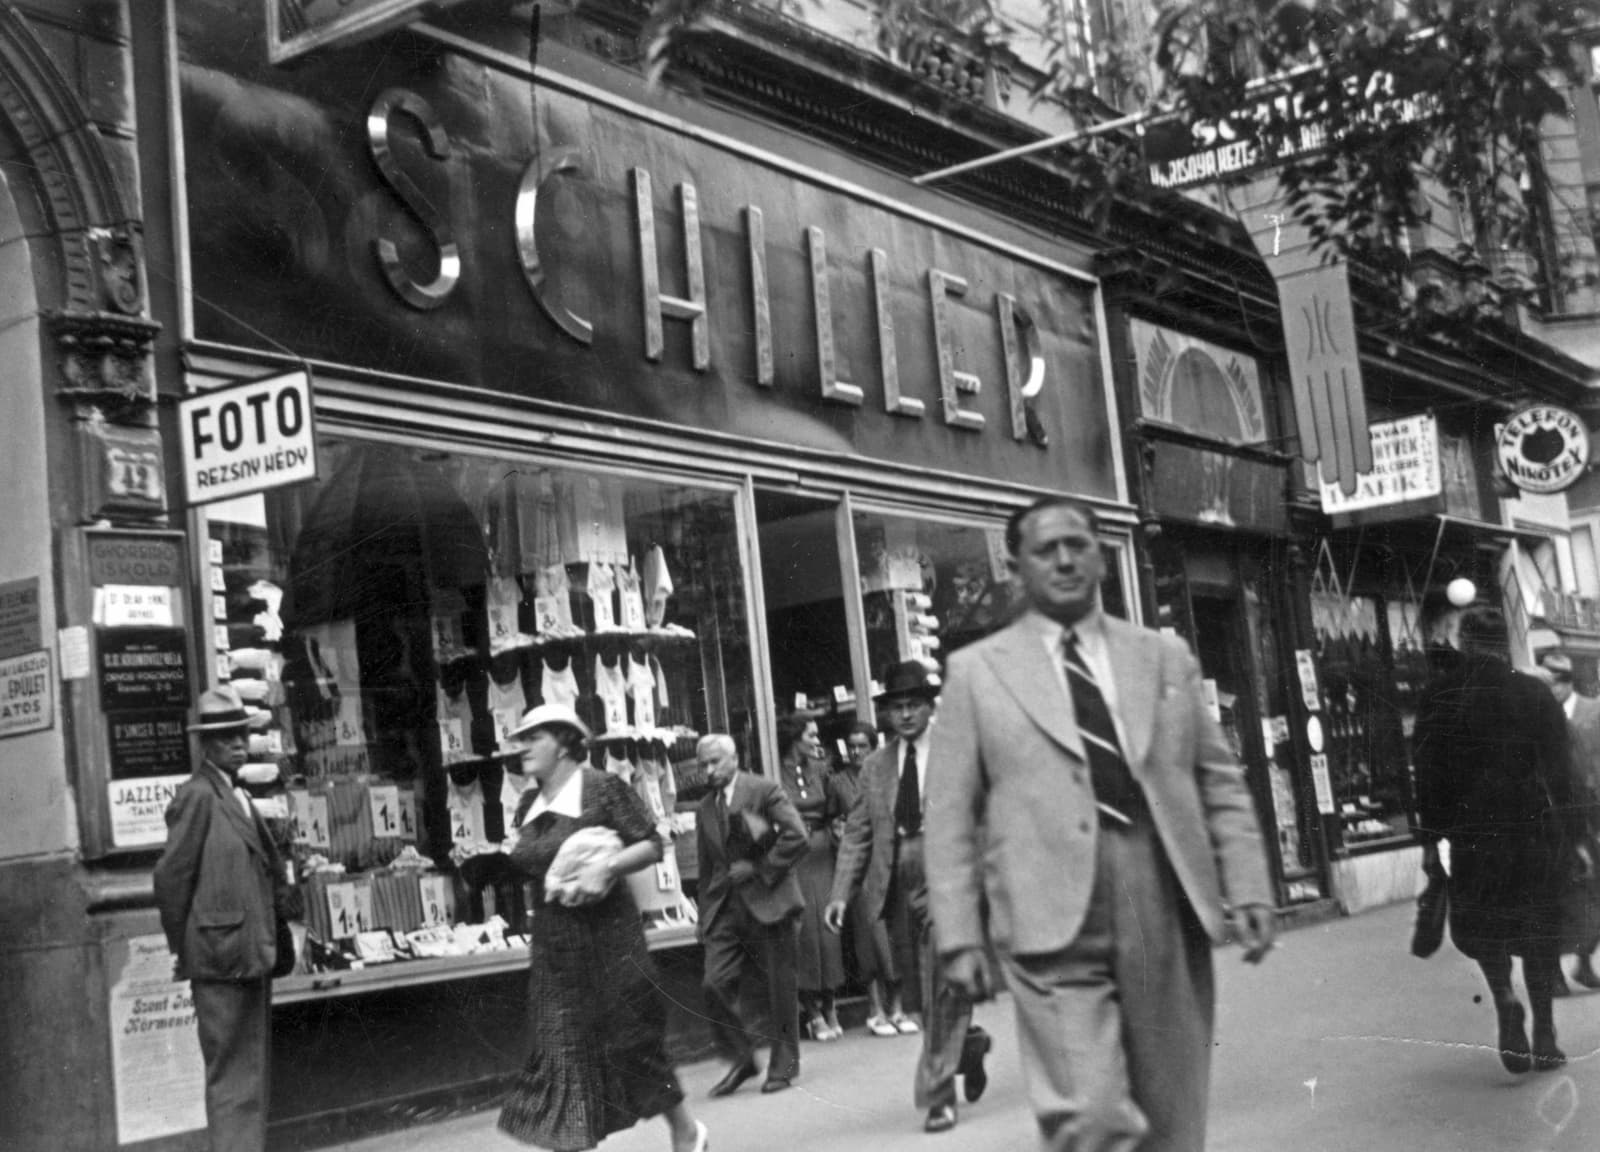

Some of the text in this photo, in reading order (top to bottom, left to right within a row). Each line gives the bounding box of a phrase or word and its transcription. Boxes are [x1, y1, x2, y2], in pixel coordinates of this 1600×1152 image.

[367, 89, 1049, 447] SCHILLER
[191, 385, 303, 461] FOTO
[1502, 410, 1579, 448] TELEFON
[114, 782, 178, 806] JAZZÉN
